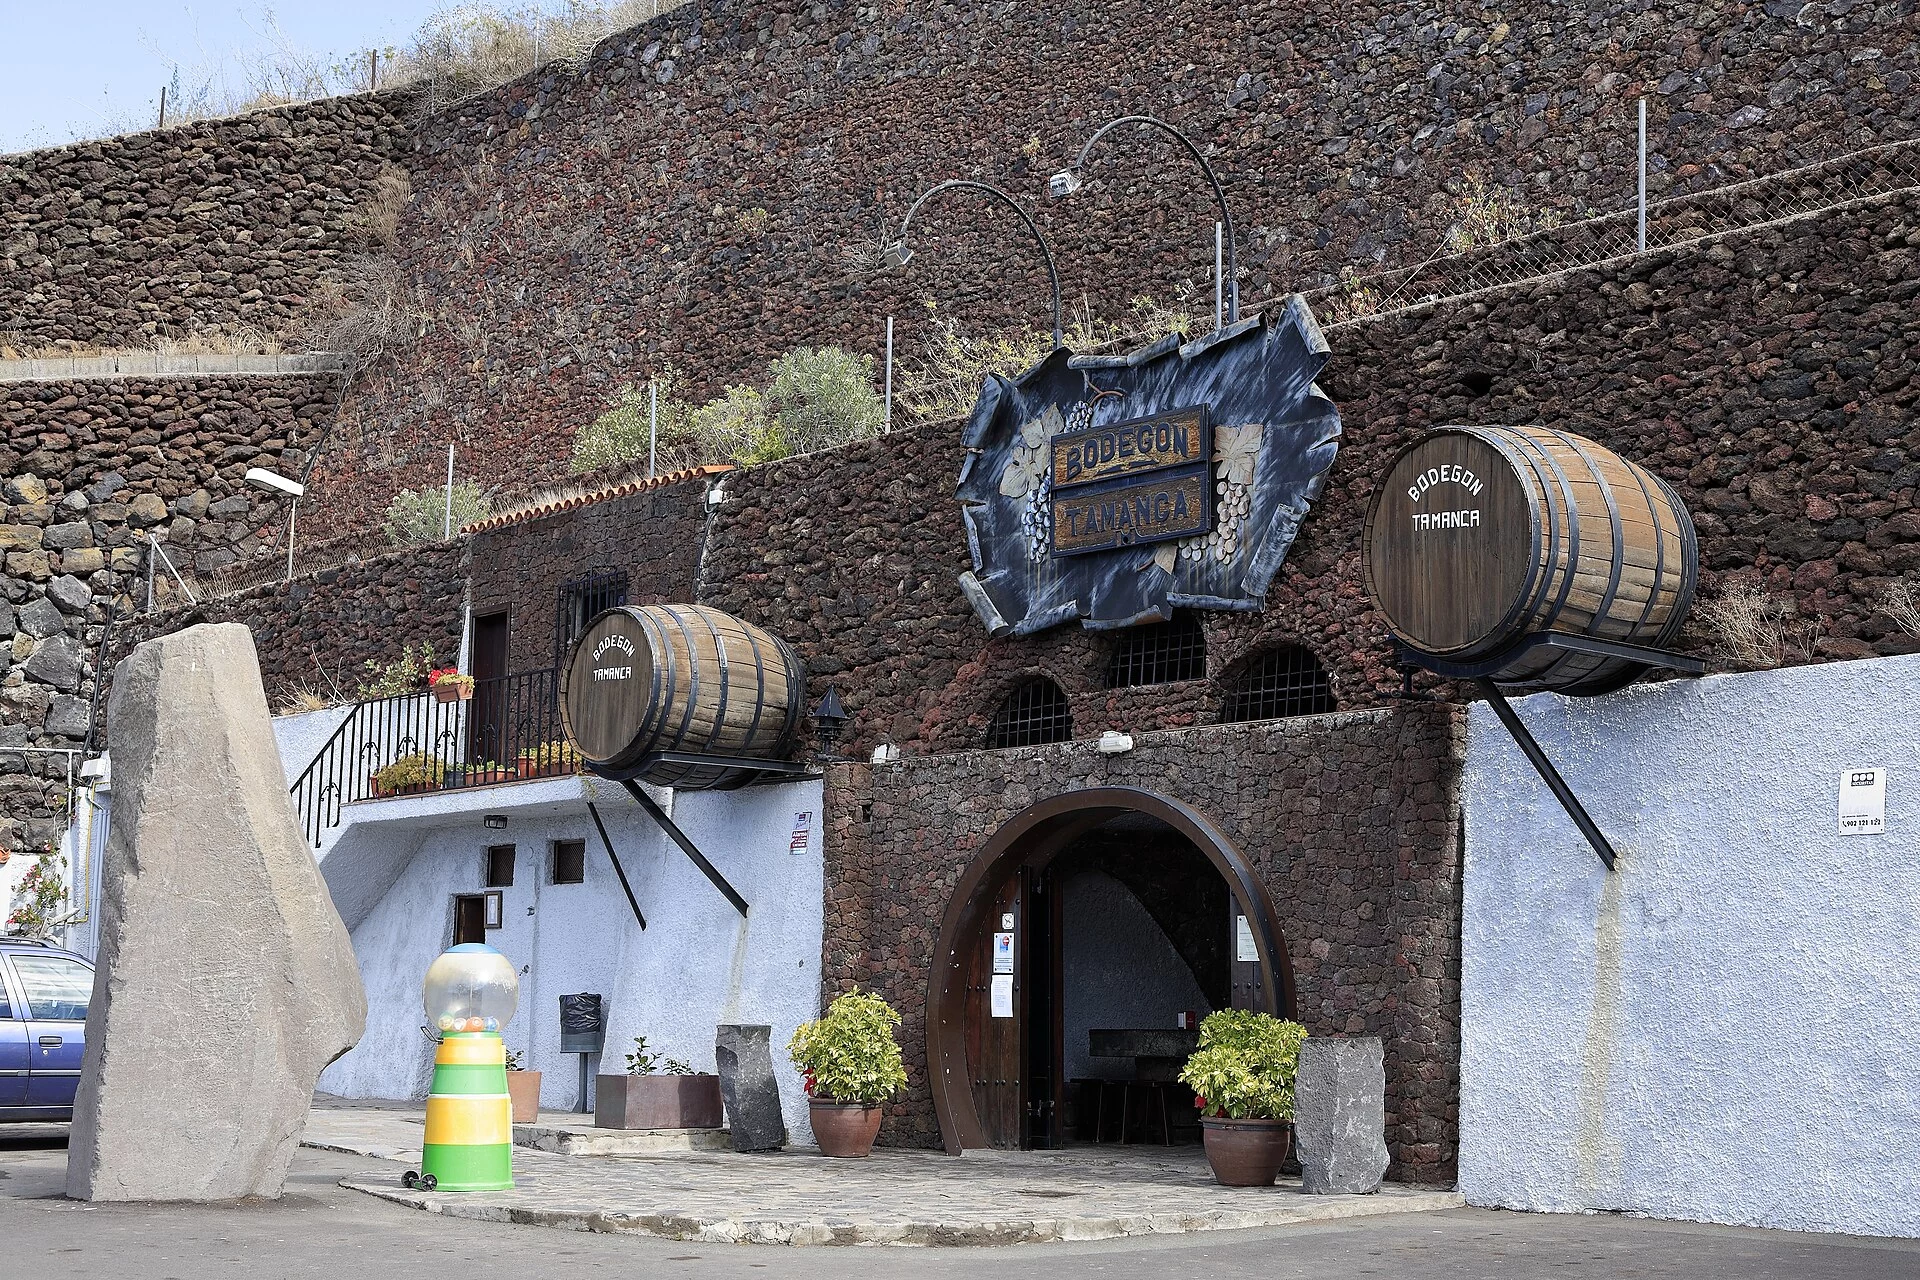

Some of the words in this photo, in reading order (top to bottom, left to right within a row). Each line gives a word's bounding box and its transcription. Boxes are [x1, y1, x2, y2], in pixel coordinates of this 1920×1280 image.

[1066, 422, 1188, 481] BODEGON
[1407, 464, 1484, 503] BODEGON
[1411, 509, 1480, 532] TAMANCA
[592, 634, 636, 662] BODEGON
[593, 666, 632, 682] TAMANCA
